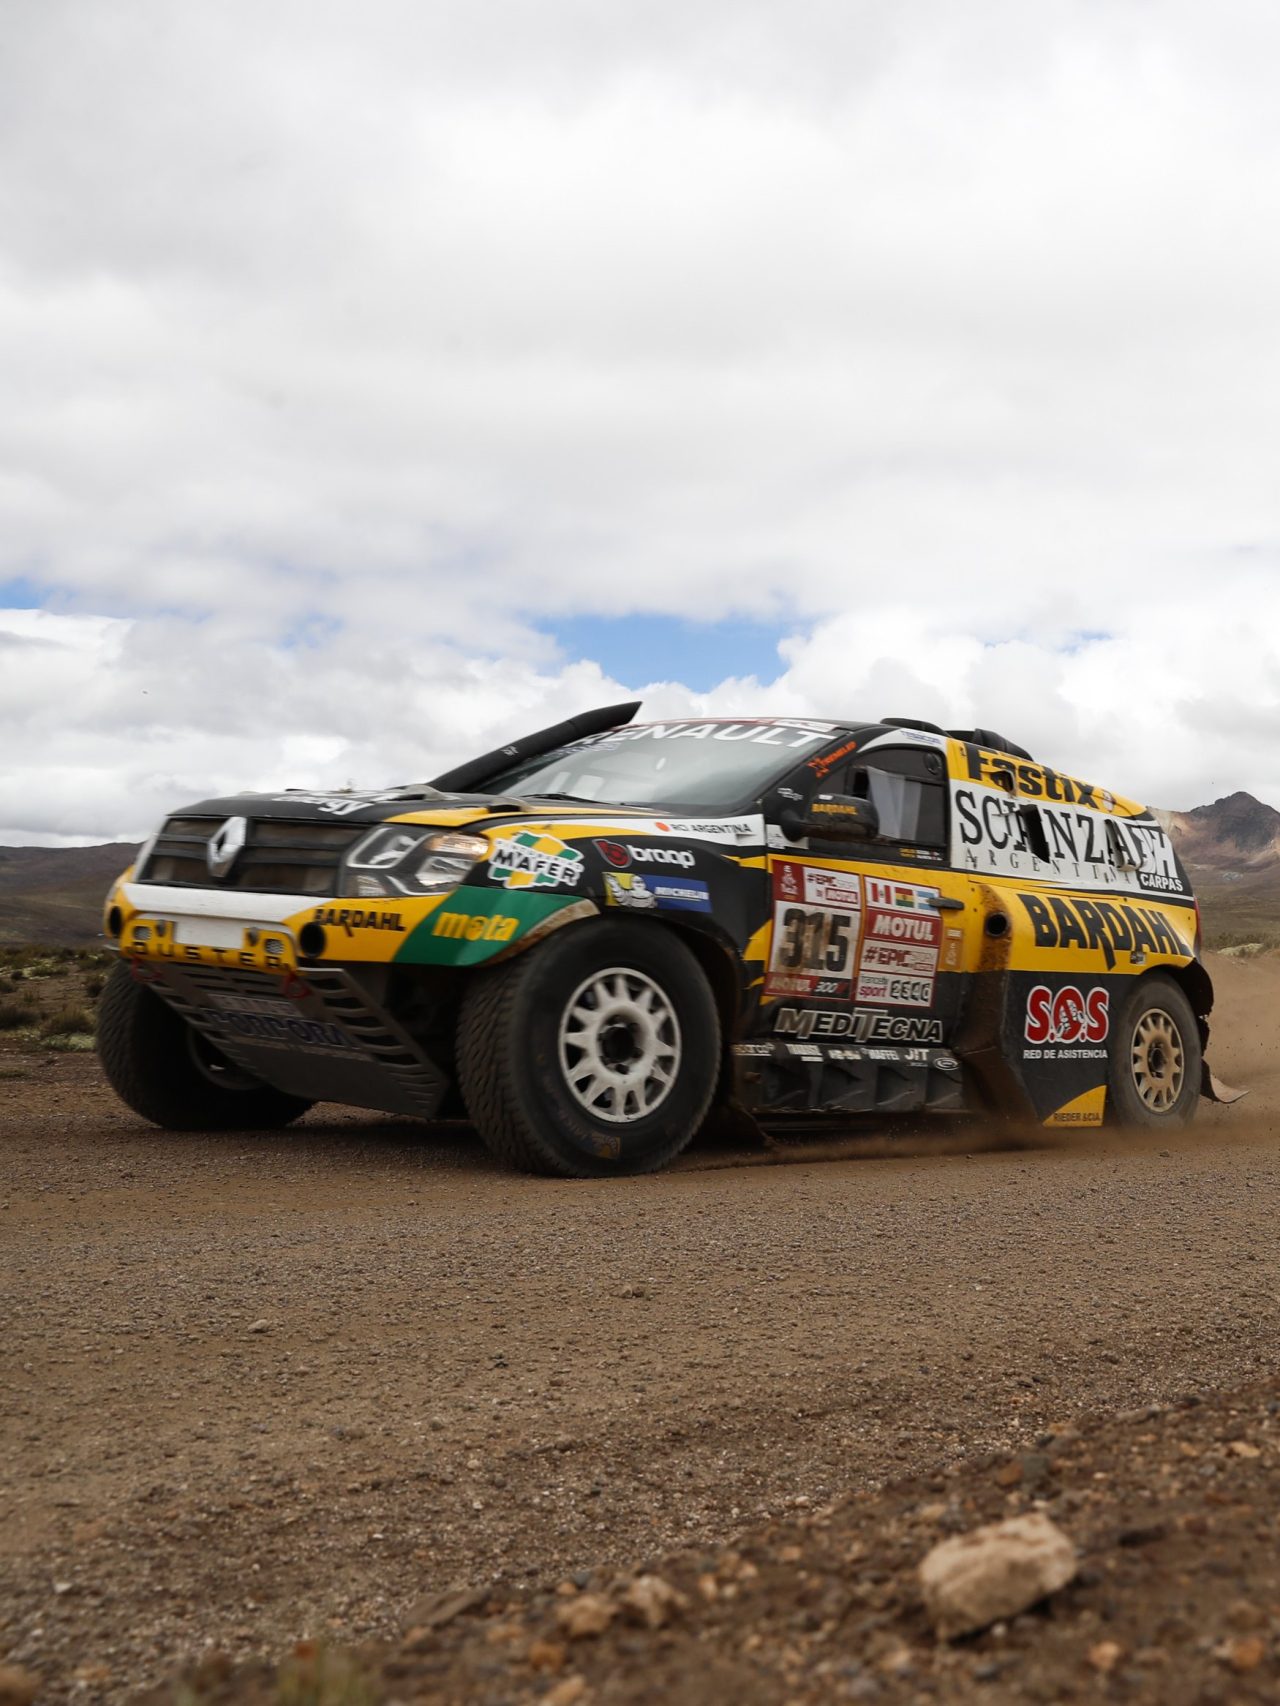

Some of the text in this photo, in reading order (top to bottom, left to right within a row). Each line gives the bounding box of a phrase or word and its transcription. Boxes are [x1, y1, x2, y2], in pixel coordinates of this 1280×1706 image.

[562, 724, 838, 748] RENAULT
[964, 743, 1099, 809] Fastix
[691, 823, 752, 834] ARGENTINA
[1140, 873, 1183, 892] CARPAS
[314, 908, 406, 937] BARDAHL
[873, 914, 933, 941] MOTUL
[1017, 893, 1194, 971] BARDAHL
[779, 908, 851, 972] 315
[132, 941, 284, 968] DUSTER
[859, 983, 888, 998] sport
[1023, 1050, 1108, 1059] RED DE ASISTENCIA
